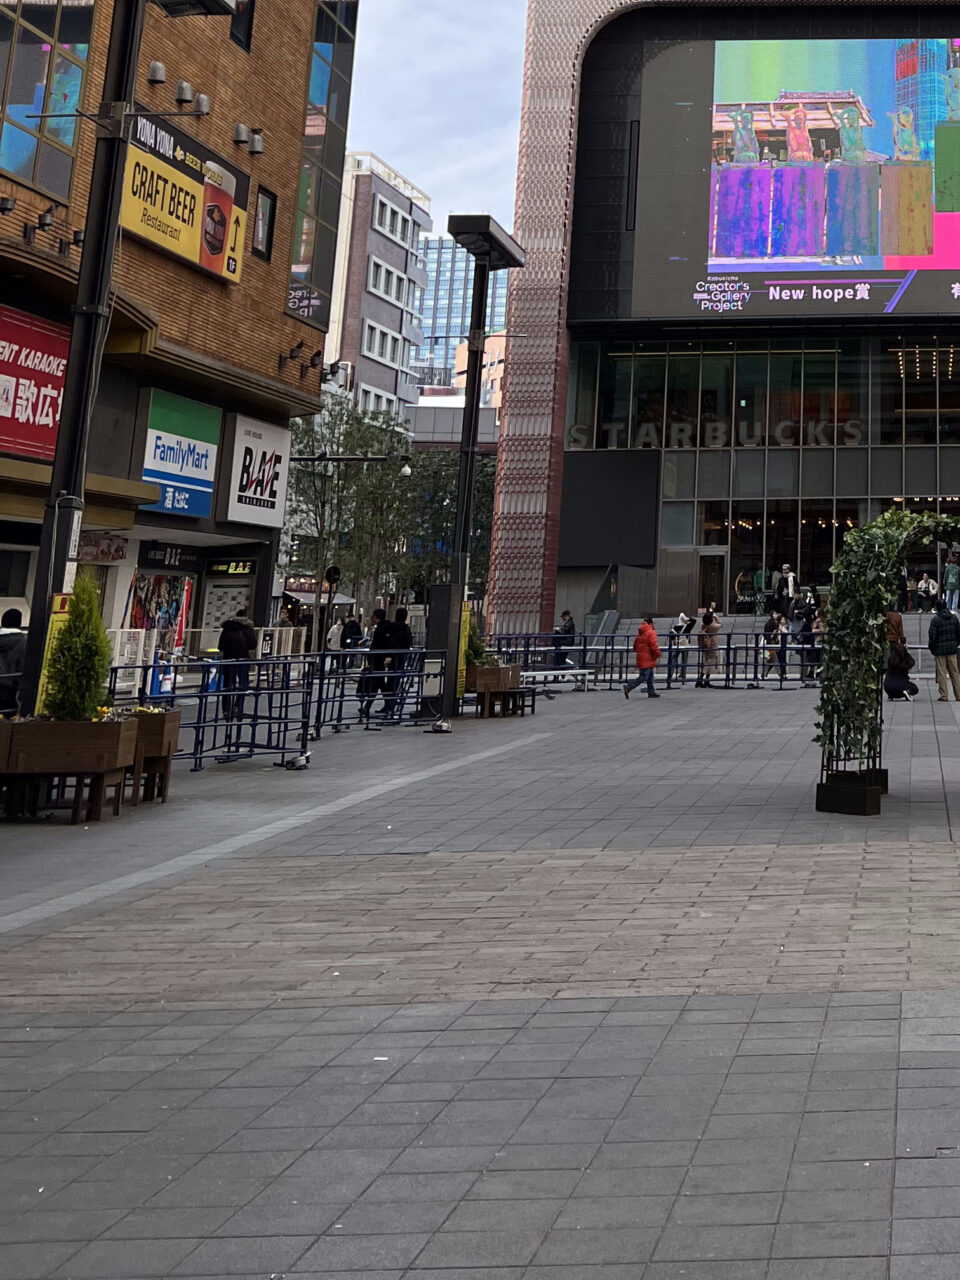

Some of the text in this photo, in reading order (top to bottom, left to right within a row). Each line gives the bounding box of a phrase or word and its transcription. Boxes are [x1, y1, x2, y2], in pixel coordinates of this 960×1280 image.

[136, 115, 155, 147] YONA
[155, 127, 175, 159] YONA
[185, 152, 201, 172] BEER
[131, 161, 197, 228] CRAFT BEER
[140, 207, 181, 242] Restaurant
[229, 259, 236, 272] 1F
[695, 281, 750, 291] Creator's
[711, 290, 751, 303] Gallery
[768, 283, 871, 302] New hope賞
[701, 300, 743, 312] Project
[17, 347, 68, 377] KARAOKE
[568, 420, 863, 449] STARBUCKS
[153, 435, 209, 472] FamilyMart
[238, 444, 283, 499] BLAZE
[164, 487, 189, 510] 酒 たばこ
